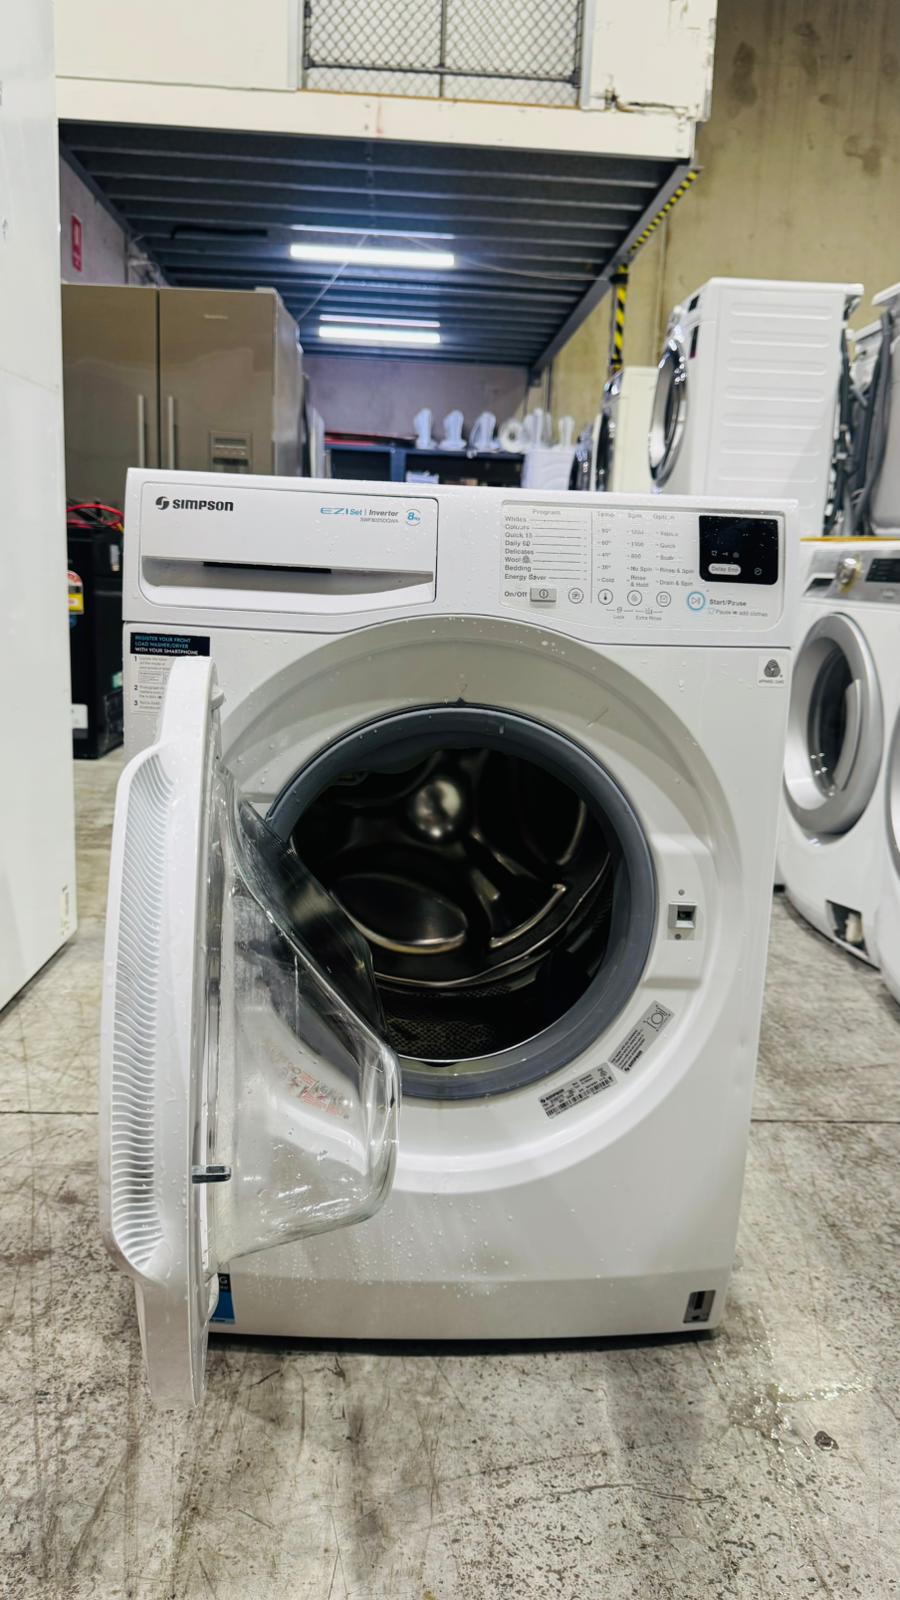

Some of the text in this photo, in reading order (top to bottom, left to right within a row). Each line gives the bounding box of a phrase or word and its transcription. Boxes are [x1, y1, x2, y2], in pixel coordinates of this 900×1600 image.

[172, 499, 234, 511] SIMPSON
[369, 509, 399, 517] Inverter
[504, 564, 532, 572] Bedding
[504, 573, 527, 581] Energy
[504, 590, 528, 598] On/Off
[709, 599, 747, 607] Start/Pause
[163, 648, 198, 656] SMARTPHONE
